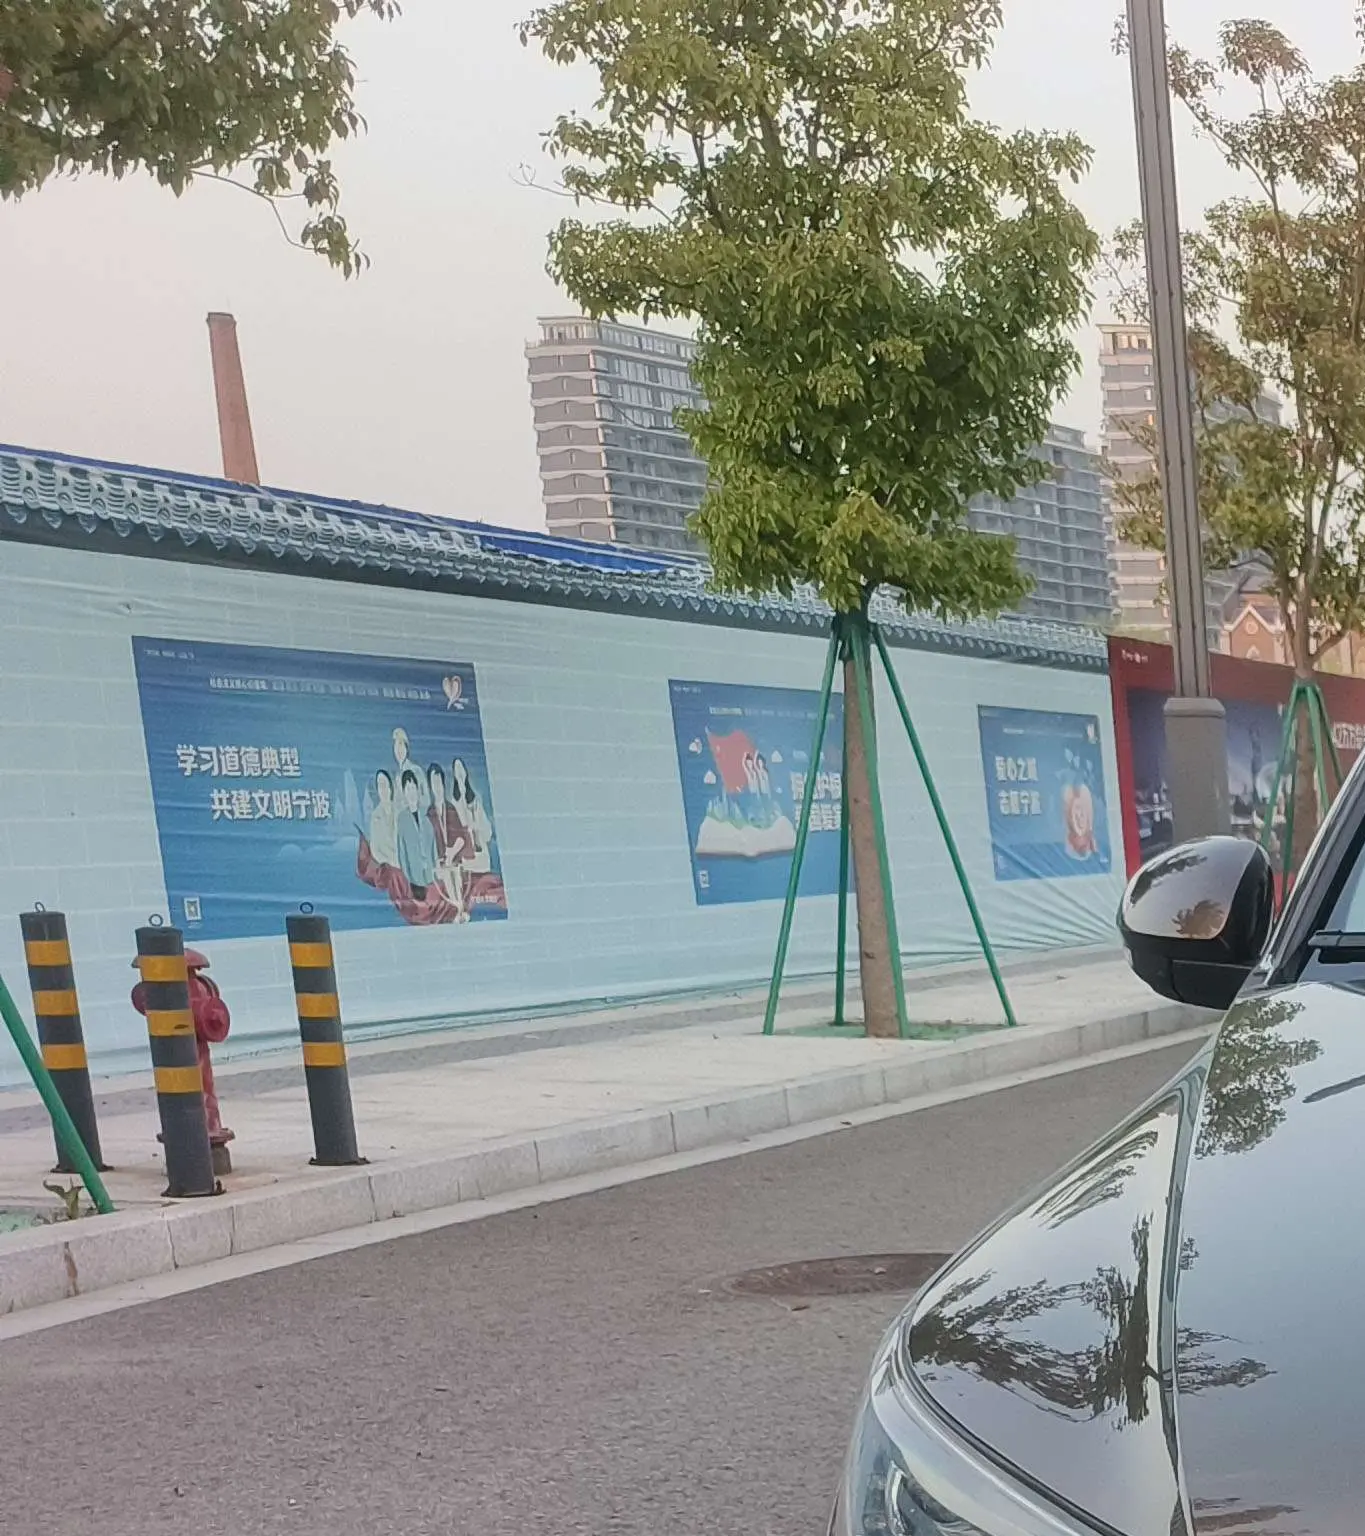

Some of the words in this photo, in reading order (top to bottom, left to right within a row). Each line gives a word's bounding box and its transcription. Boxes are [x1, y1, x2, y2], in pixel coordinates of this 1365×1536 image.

[176, 744, 302, 778] 学习道德典型
[210, 789, 332, 822] 共建文明宁波
